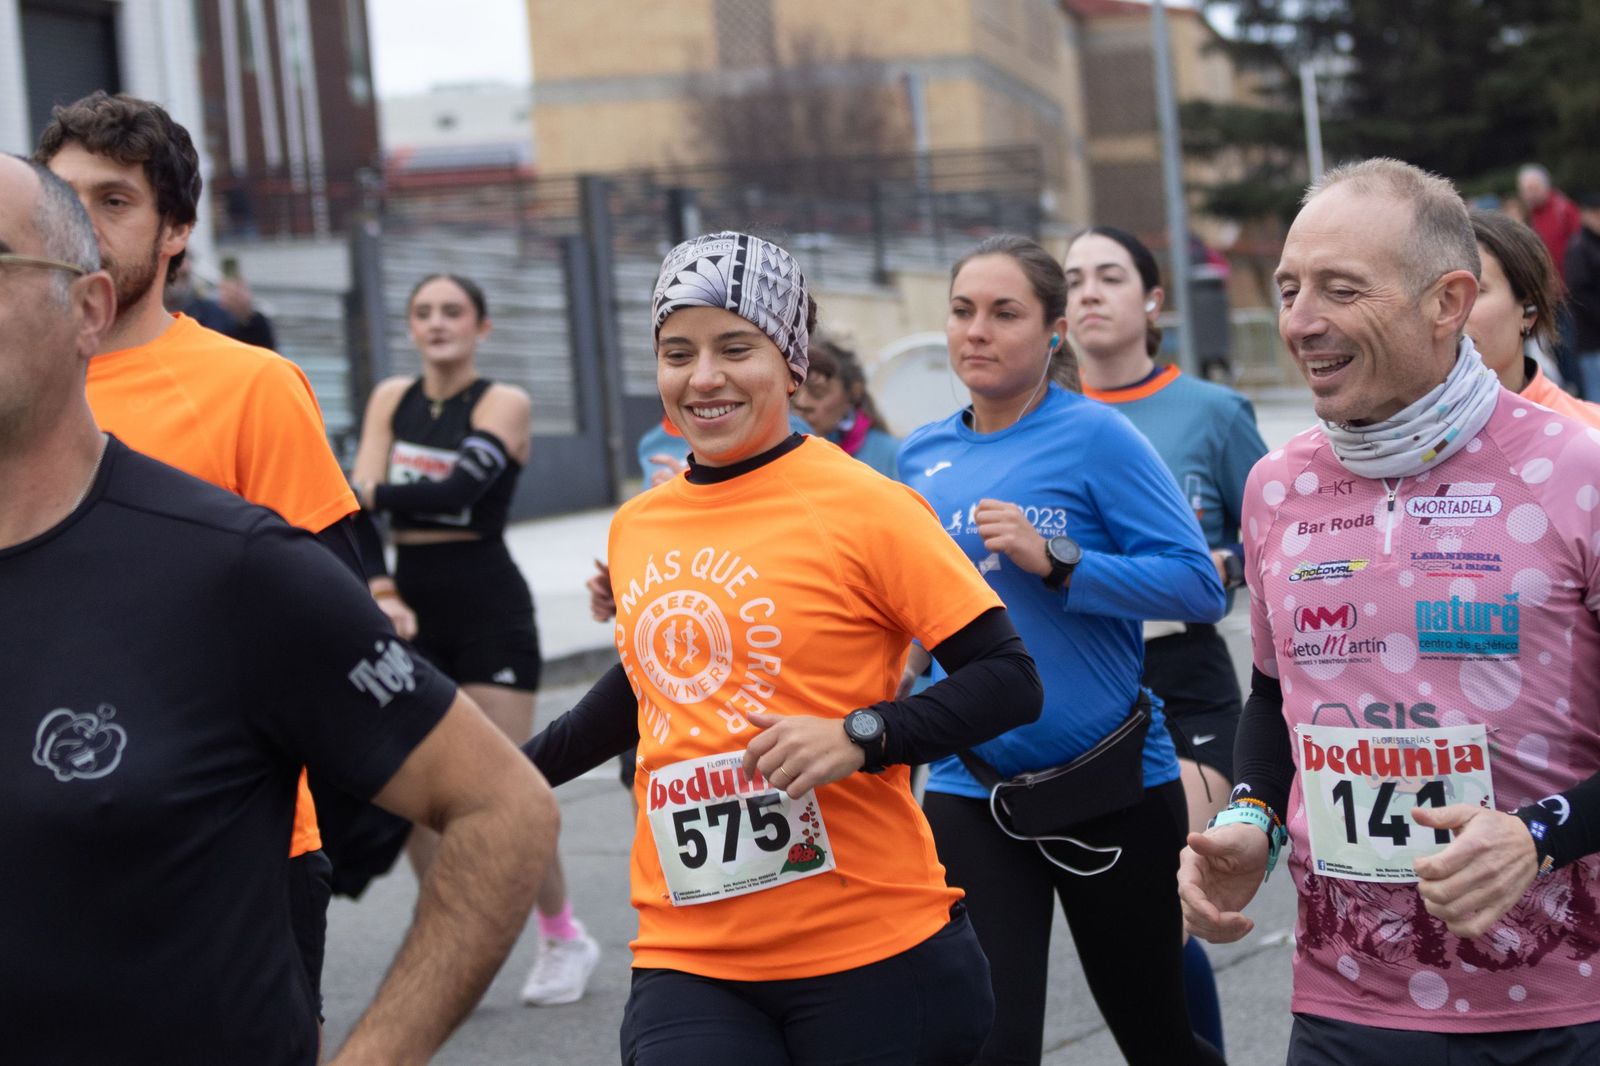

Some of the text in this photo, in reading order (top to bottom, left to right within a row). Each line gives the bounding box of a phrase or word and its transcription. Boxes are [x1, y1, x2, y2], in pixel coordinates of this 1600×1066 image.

[1019, 505, 1067, 530] 023
[1298, 513, 1375, 536] Bar Roda
[1413, 499, 1492, 515] MORTADELA
[621, 550, 681, 615] MÁS
[691, 547, 759, 599] QUE
[651, 594, 710, 618] BEER
[1419, 640, 1453, 649] centro
[1456, 638, 1471, 649] de
[643, 654, 729, 699] RUNNERS
[716, 597, 782, 735] CORRER
[1303, 735, 1485, 777] bedunia
[1371, 736, 1431, 745] FLORISTERÍAS
[672, 792, 791, 870] 575
[1332, 779, 1452, 847] 141
